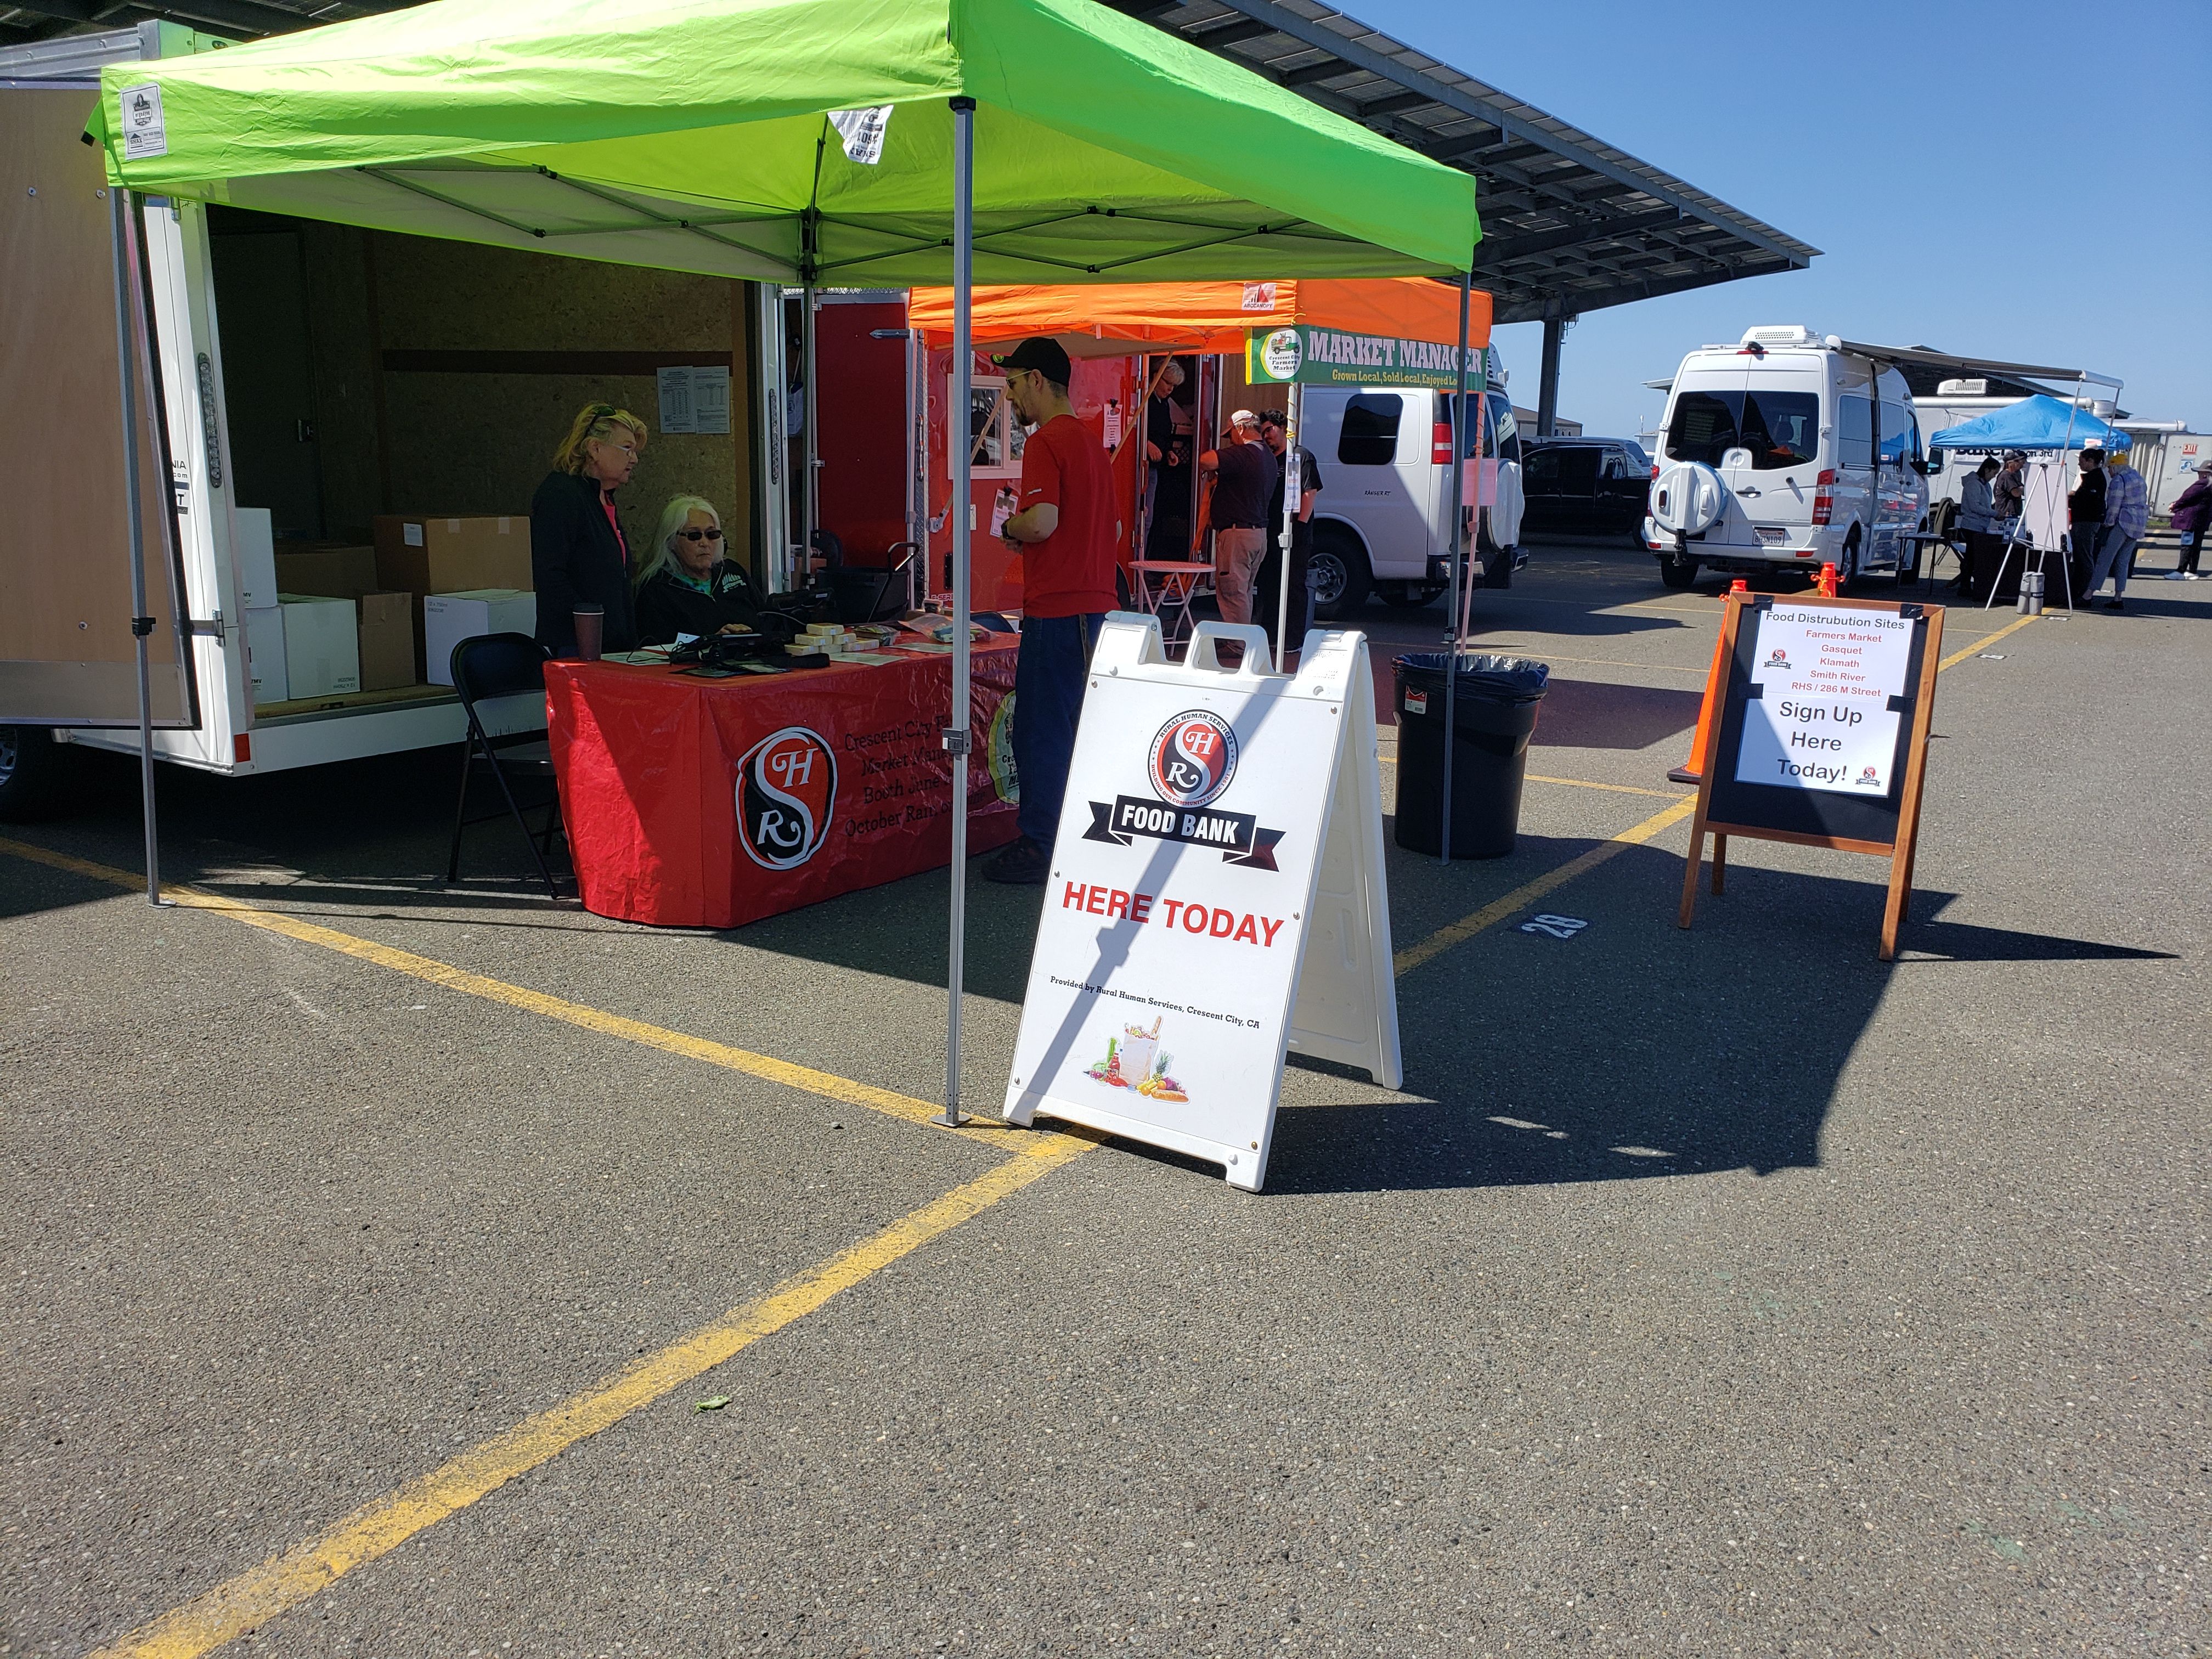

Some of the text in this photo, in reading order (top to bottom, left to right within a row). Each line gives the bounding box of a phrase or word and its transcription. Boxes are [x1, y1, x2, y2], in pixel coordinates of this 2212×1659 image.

[1308, 331, 1395, 367] MARKET
[1332, 369, 1357, 381] Grown
[1383, 371, 1399, 383] Sold
[1422, 374, 1448, 387] Enjoyed
[1766, 612, 1905, 629] Food Distrubution Sites
[1806, 630, 1882, 642] Farmers Market
[1820, 657, 1859, 668] Klamath
[1821, 645, 1863, 655] Gasquet
[1810, 670, 1866, 682] Smith River
[1791, 682, 1813, 691] RHS
[1820, 684, 1838, 693] 286
[1840, 686, 1848, 694] M
[1851, 687, 1881, 697] Street
[1780, 701, 1863, 727] Sign Up
[845, 726, 902, 751] Crescent
[905, 721, 932, 738] City
[1160, 713, 1234, 746] RURAL HUMAN SERVICES
[1791, 731, 1842, 751] Here
[861, 752, 910, 777] Market
[1777, 759, 1847, 783] Today!
[864, 779, 904, 804] Booth
[909, 775, 940, 794] June
[1151, 764, 1231, 806] BUILDING OUR COMMUNITY SINCE 1981
[845, 811, 902, 837] October
[1121, 805, 1239, 844] FOOD BANK
[1062, 881, 1285, 947] HERE TODAY
[1050, 976, 1260, 1029] Provided by Rural Human Services, Crescent City, CA
